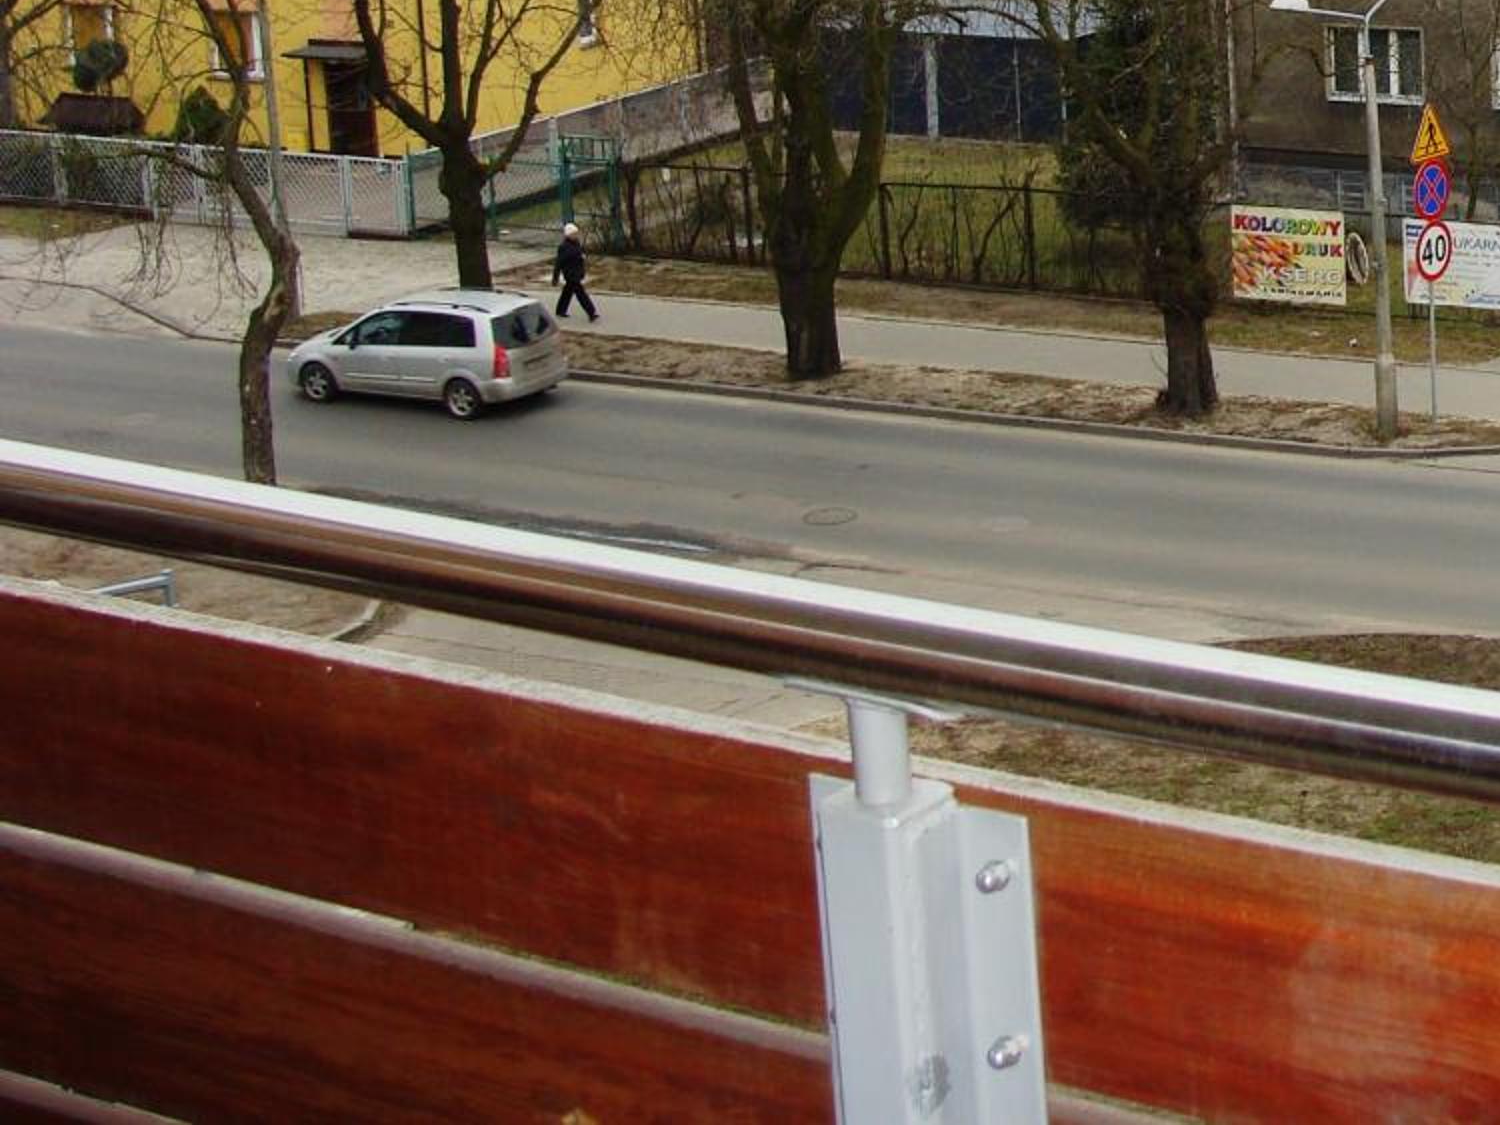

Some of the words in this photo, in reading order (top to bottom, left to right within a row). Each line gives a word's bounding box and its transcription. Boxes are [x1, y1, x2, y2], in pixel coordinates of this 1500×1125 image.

[1234, 214, 1341, 236] KOLOROWY
[1293, 242, 1343, 257] DRUK
[1422, 235, 1446, 265] 40
